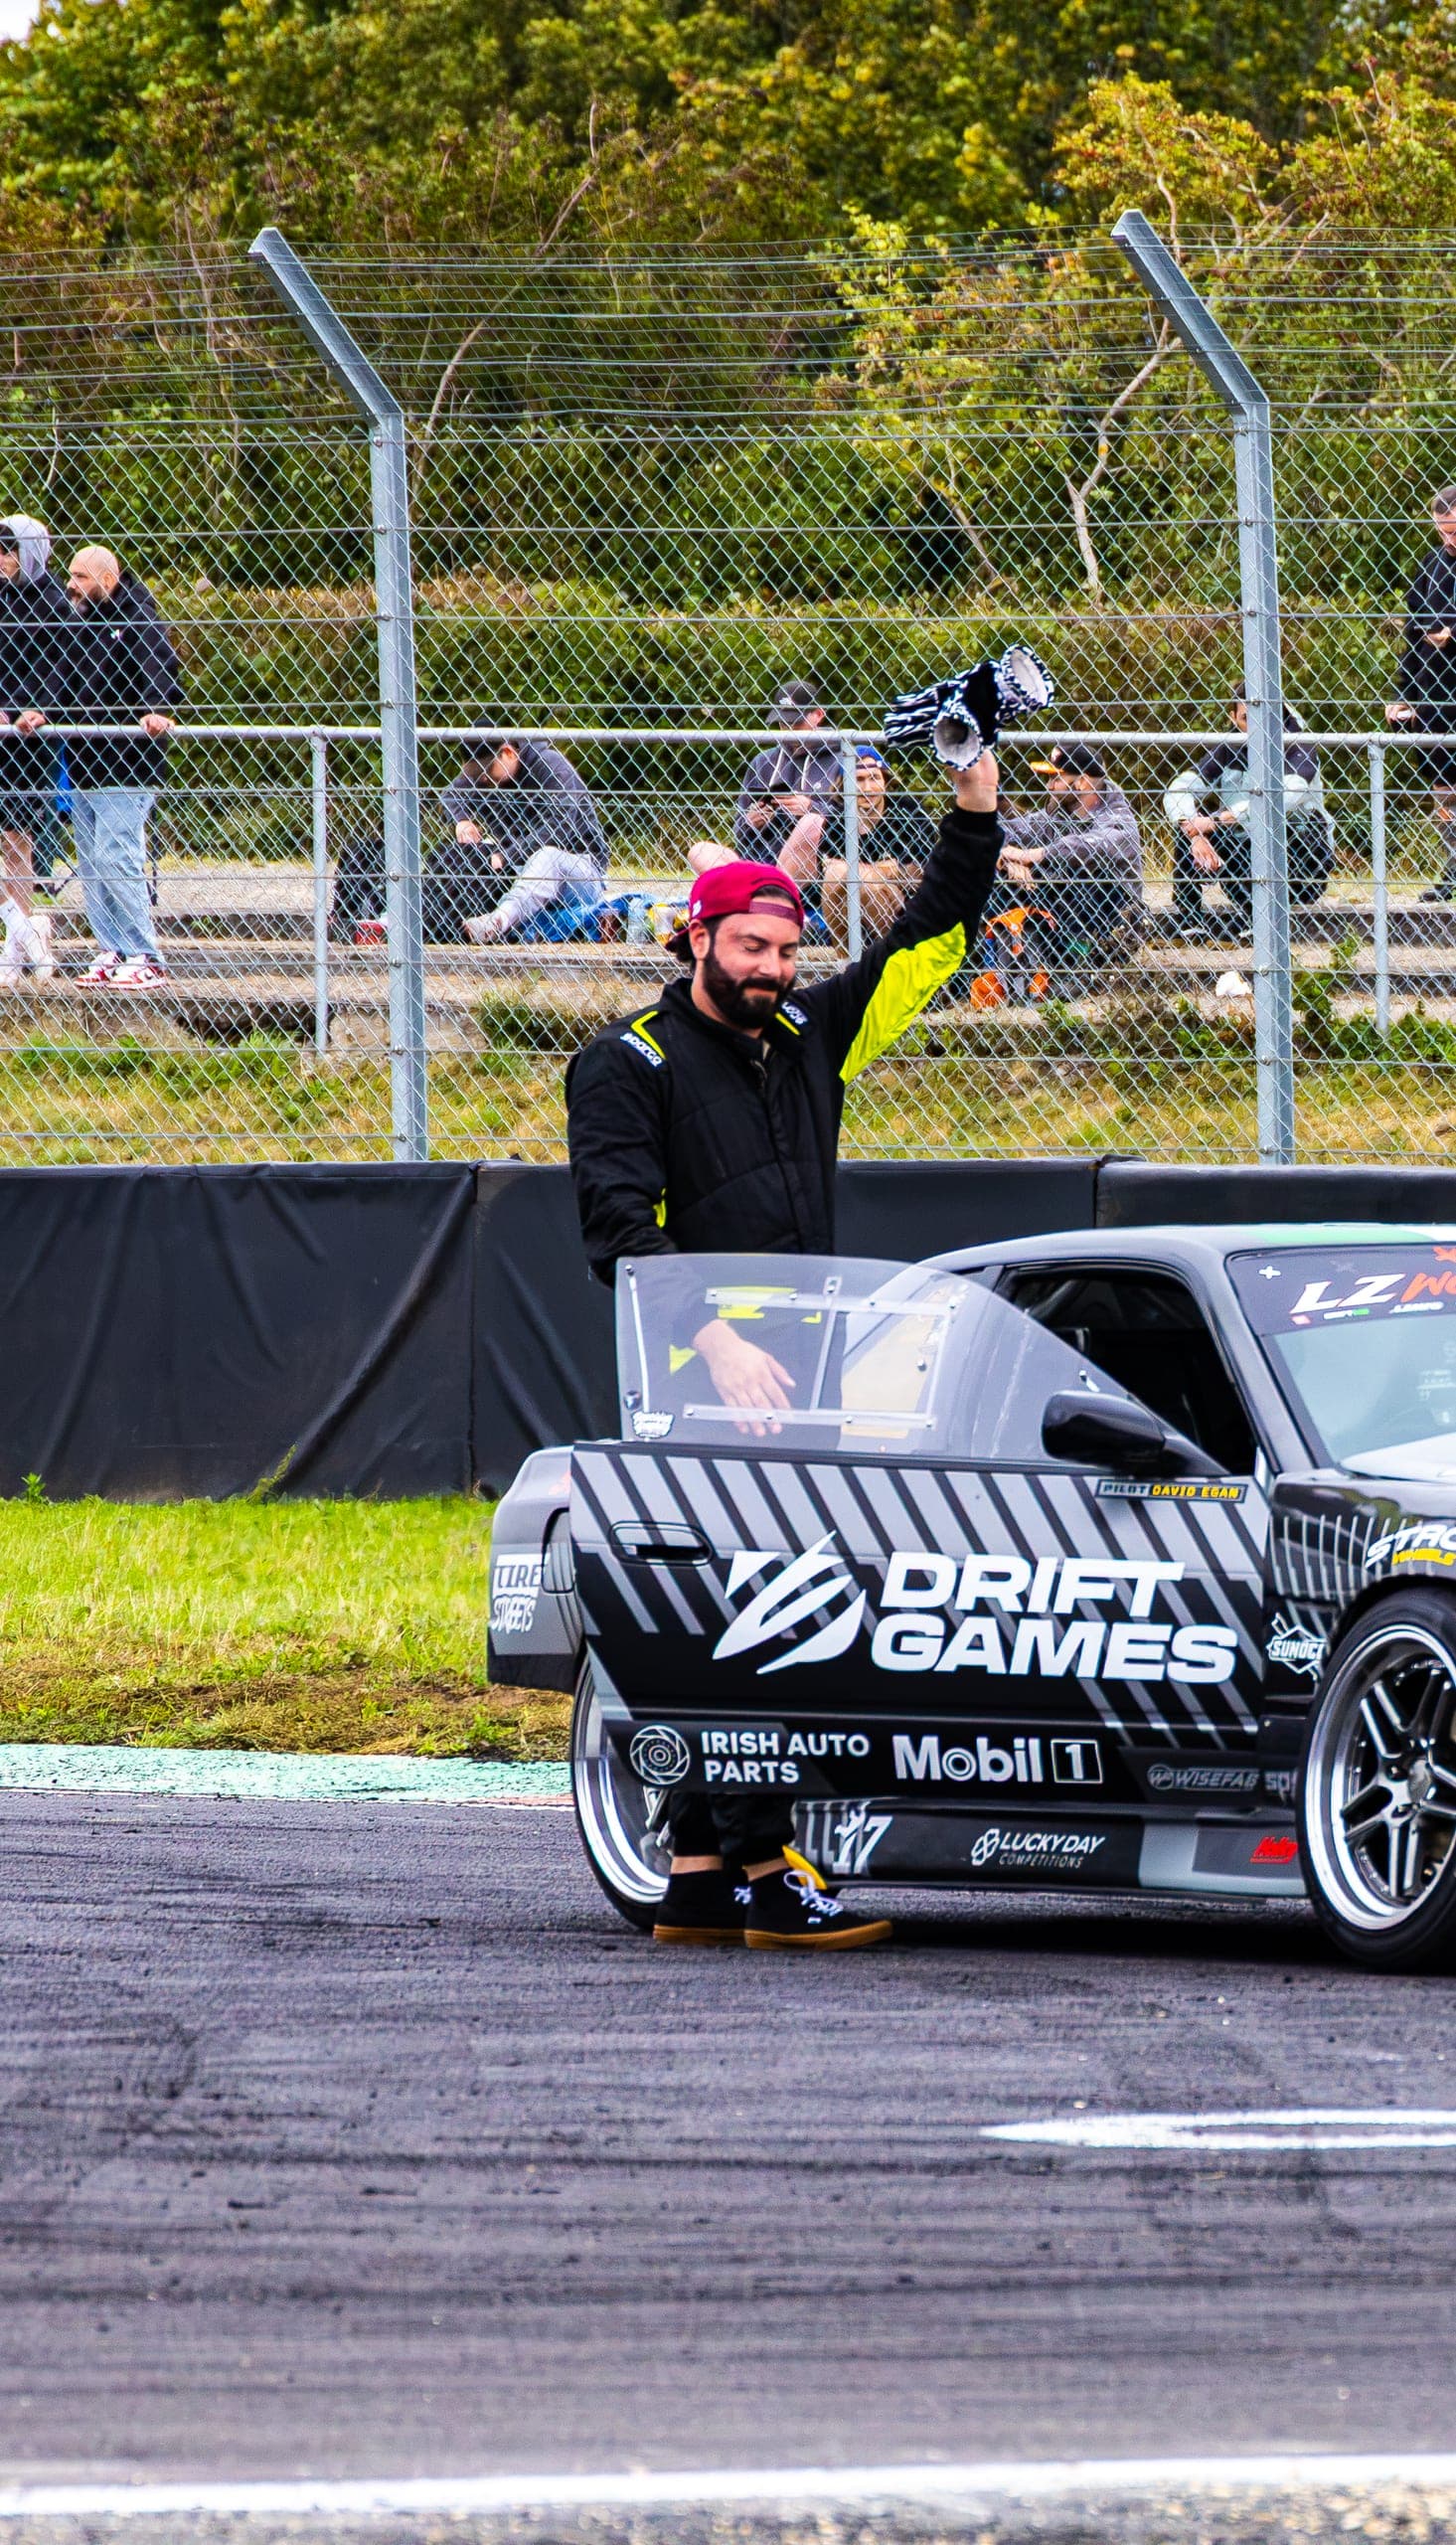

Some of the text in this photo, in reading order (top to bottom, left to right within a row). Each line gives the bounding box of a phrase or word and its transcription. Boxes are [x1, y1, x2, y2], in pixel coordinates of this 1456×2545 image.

[1289, 1273, 1407, 1313] LZ
[1152, 1484, 1196, 1497] DAVID
[1201, 1487, 1239, 1499] EGAN
[494, 1564, 543, 1589] TIRE
[880, 1551, 1186, 1617] DRIFT
[871, 1612, 1238, 1683] GAMES
[701, 1731, 871, 1757] IRISH AUTO
[892, 1735, 1084, 1782] Mobil 1
[704, 1760, 800, 1783] PARTS
[1174, 1770, 1260, 1788] WISEFAB
[999, 1852, 1084, 1869] COMPETITIONS
